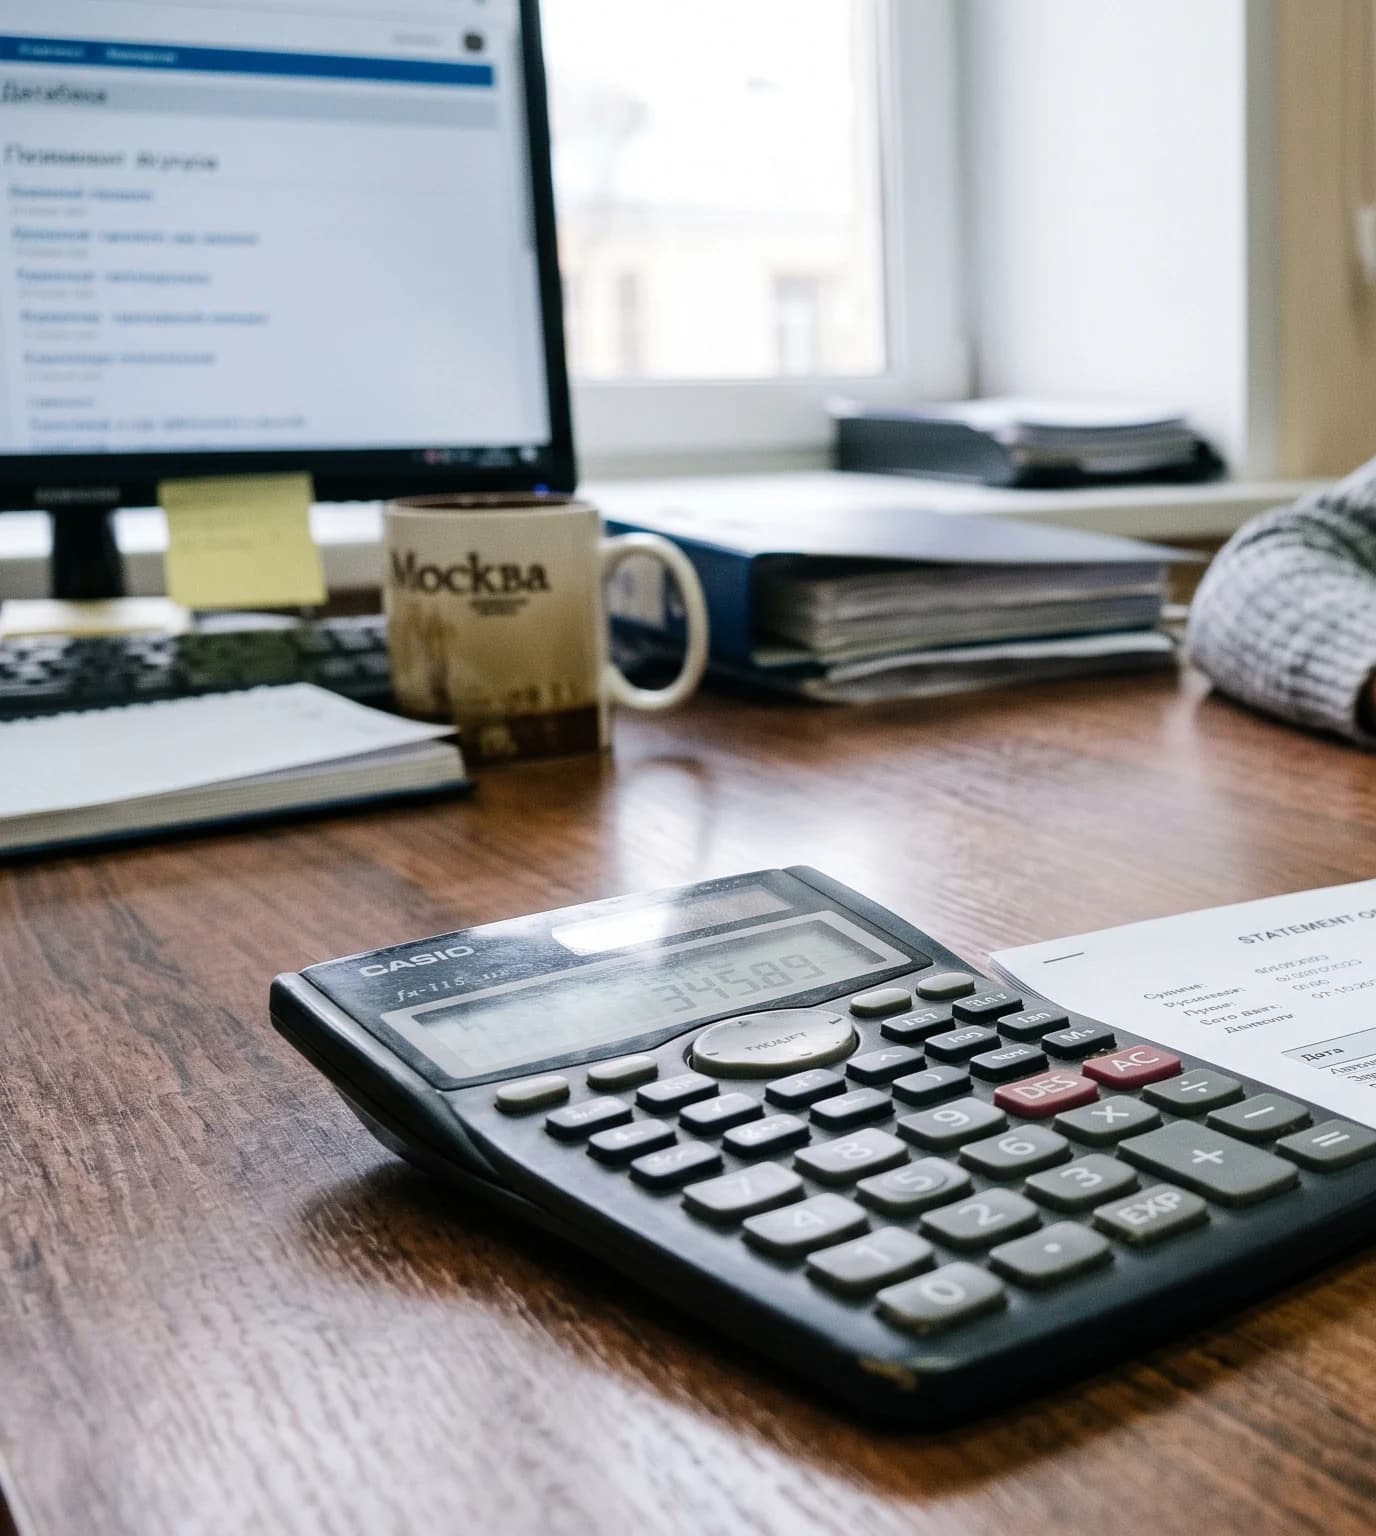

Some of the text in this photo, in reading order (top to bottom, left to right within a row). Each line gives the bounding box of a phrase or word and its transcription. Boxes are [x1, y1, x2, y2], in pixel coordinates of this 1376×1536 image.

[1237, 914, 1352, 945] STATEMENT
[359, 945, 475, 977] CASIO
[1110, 1050, 1161, 1073] AC
[1300, 1047, 1345, 1062] Дата
[1012, 1075, 1079, 1100] DES
[932, 1109, 971, 1128] 9
[832, 1141, 873, 1162] 8
[998, 1136, 1038, 1157] 6
[896, 1169, 935, 1192] 5
[1060, 1166, 1103, 1188] 3
[793, 1208, 827, 1228] 4
[957, 1202, 1007, 1227] 2
[1118, 1190, 1183, 1225] EXP
[855, 1243, 893, 1264] 1
[920, 1279, 968, 1306] 0
